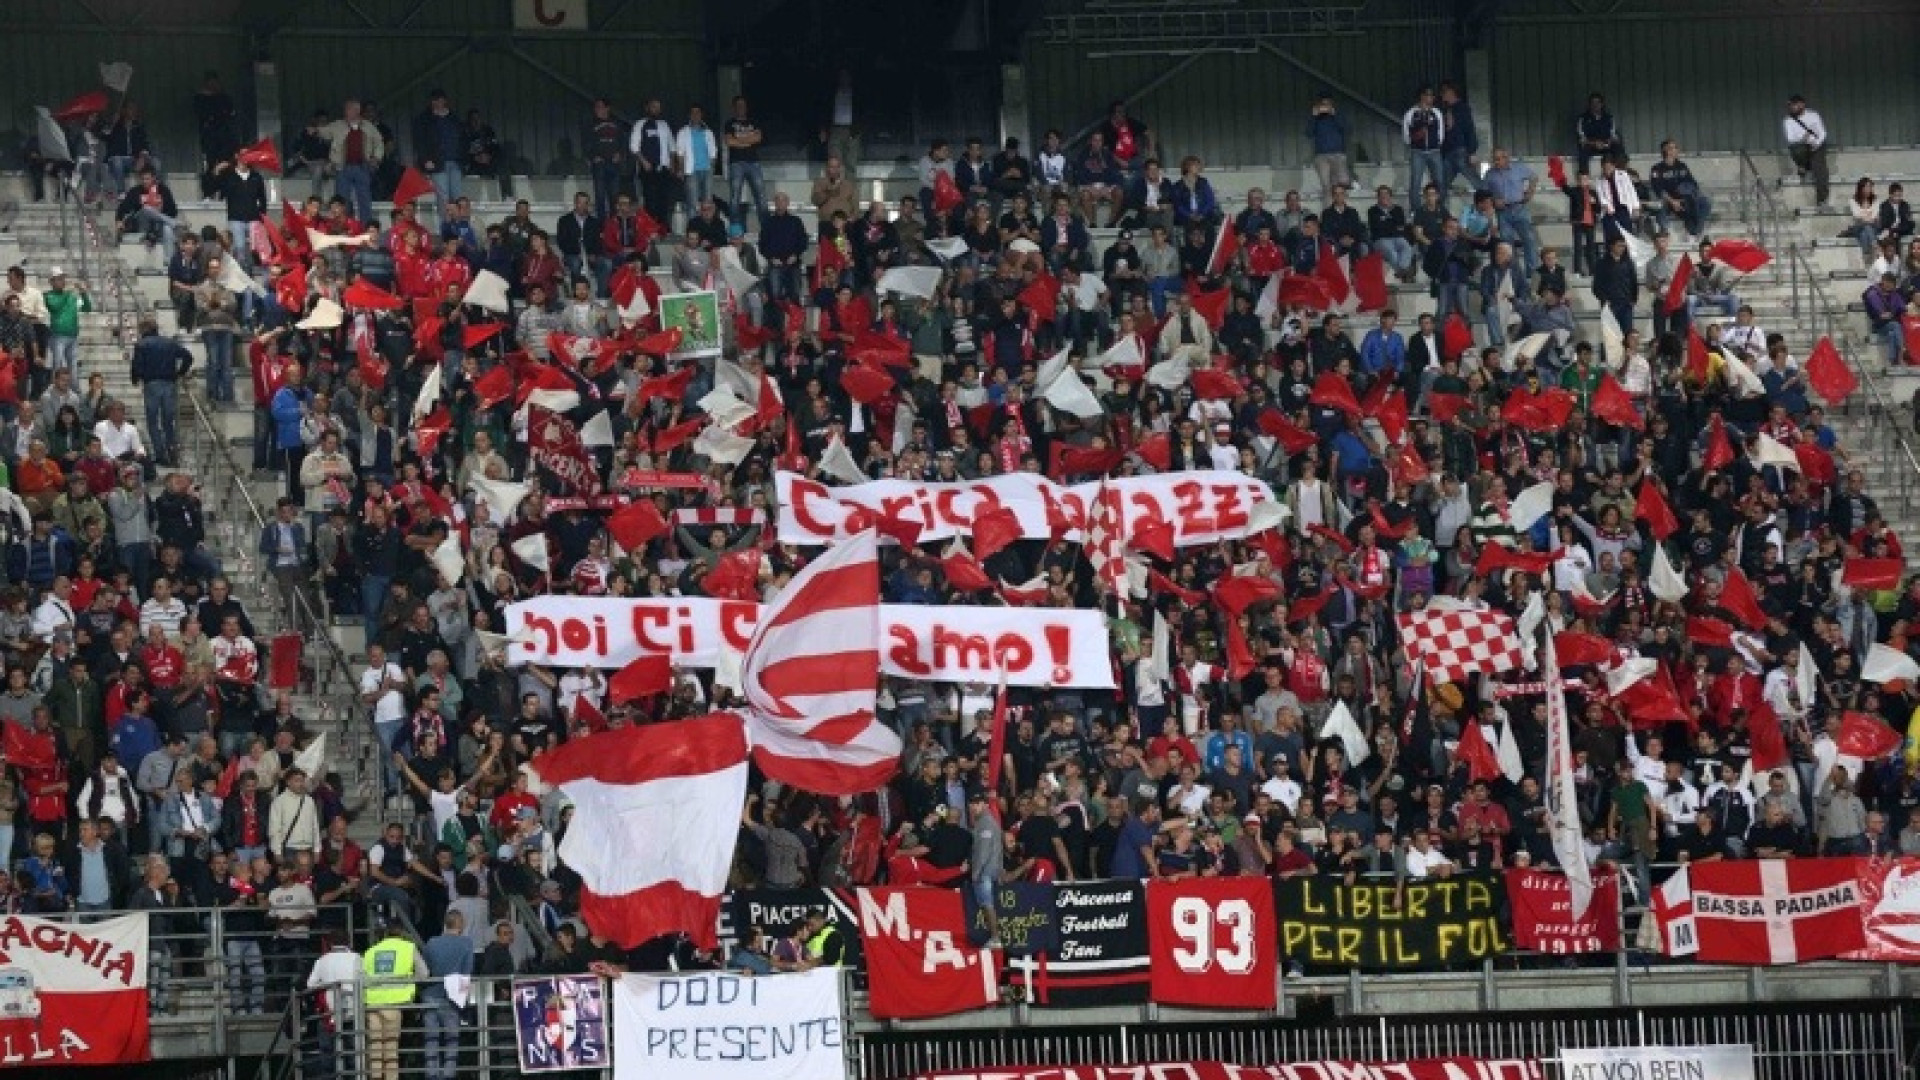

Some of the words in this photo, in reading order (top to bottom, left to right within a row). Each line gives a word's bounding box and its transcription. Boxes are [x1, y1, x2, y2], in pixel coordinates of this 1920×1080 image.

[523, 611, 607, 656] noi
[632, 606, 694, 653] Ci
[1056, 888, 1134, 908] Piacenza
[1696, 895, 1764, 916] BASSA
[1775, 886, 1855, 915] PADANA
[1061, 912, 1129, 935] Football
[1170, 896, 1255, 974] 93
[1061, 940, 1103, 960] Fans
[1283, 920, 1360, 963] PER
[1379, 928, 1420, 963] IL
[1539, 937, 1602, 954] 1919
[657, 976, 757, 1010] DODI
[647, 1015, 841, 1061] PRESENTE
